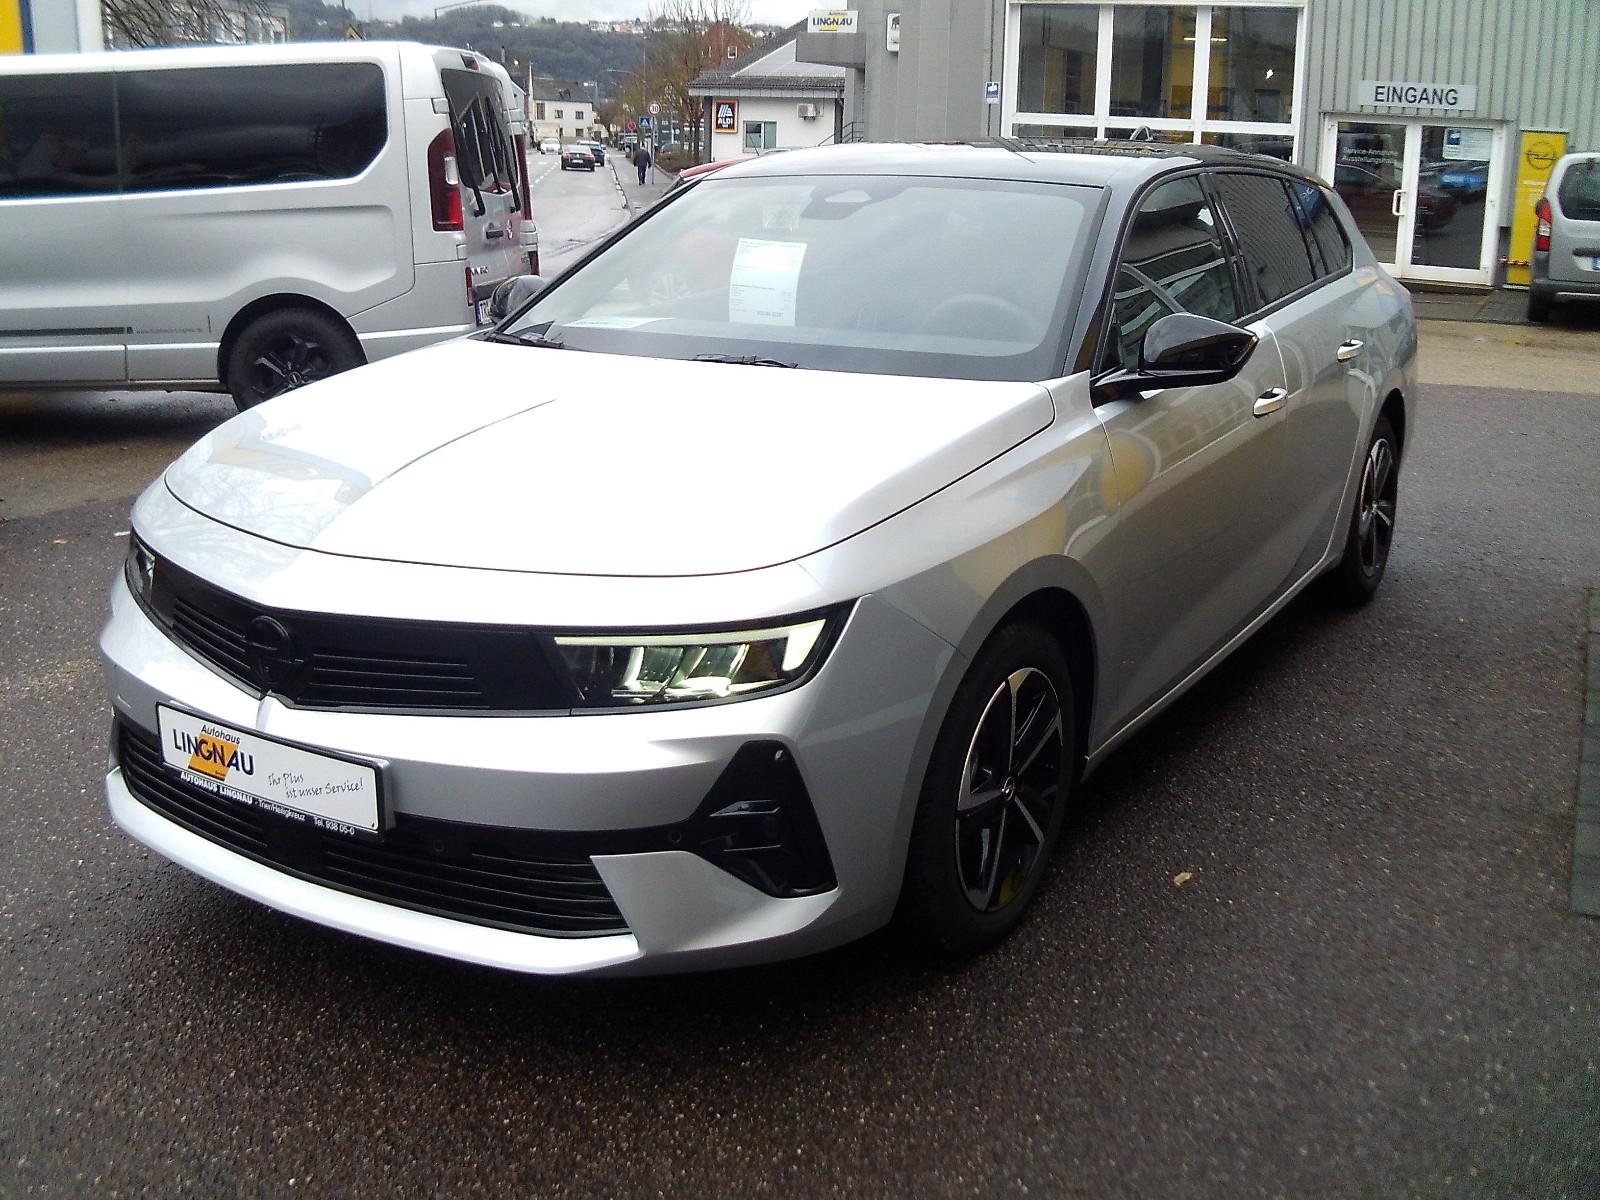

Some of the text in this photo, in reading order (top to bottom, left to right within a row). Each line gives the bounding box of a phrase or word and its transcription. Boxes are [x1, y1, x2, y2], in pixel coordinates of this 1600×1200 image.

[812, 17, 853, 26] LINGNAU
[1374, 85, 1458, 106] EINGANG
[717, 117, 733, 125] ALDI
[201, 724, 241, 745] Autohaus
[173, 728, 255, 776] LINGNAU
[268, 772, 304, 786] Ihr Plus
[286, 776, 364, 799] ist unser Service!
[180, 771, 219, 793] AUTOHAUS
[219, 785, 253, 805] LINGNAU
[313, 815, 325, 828] Tel.
[325, 820, 338, 831] 938
